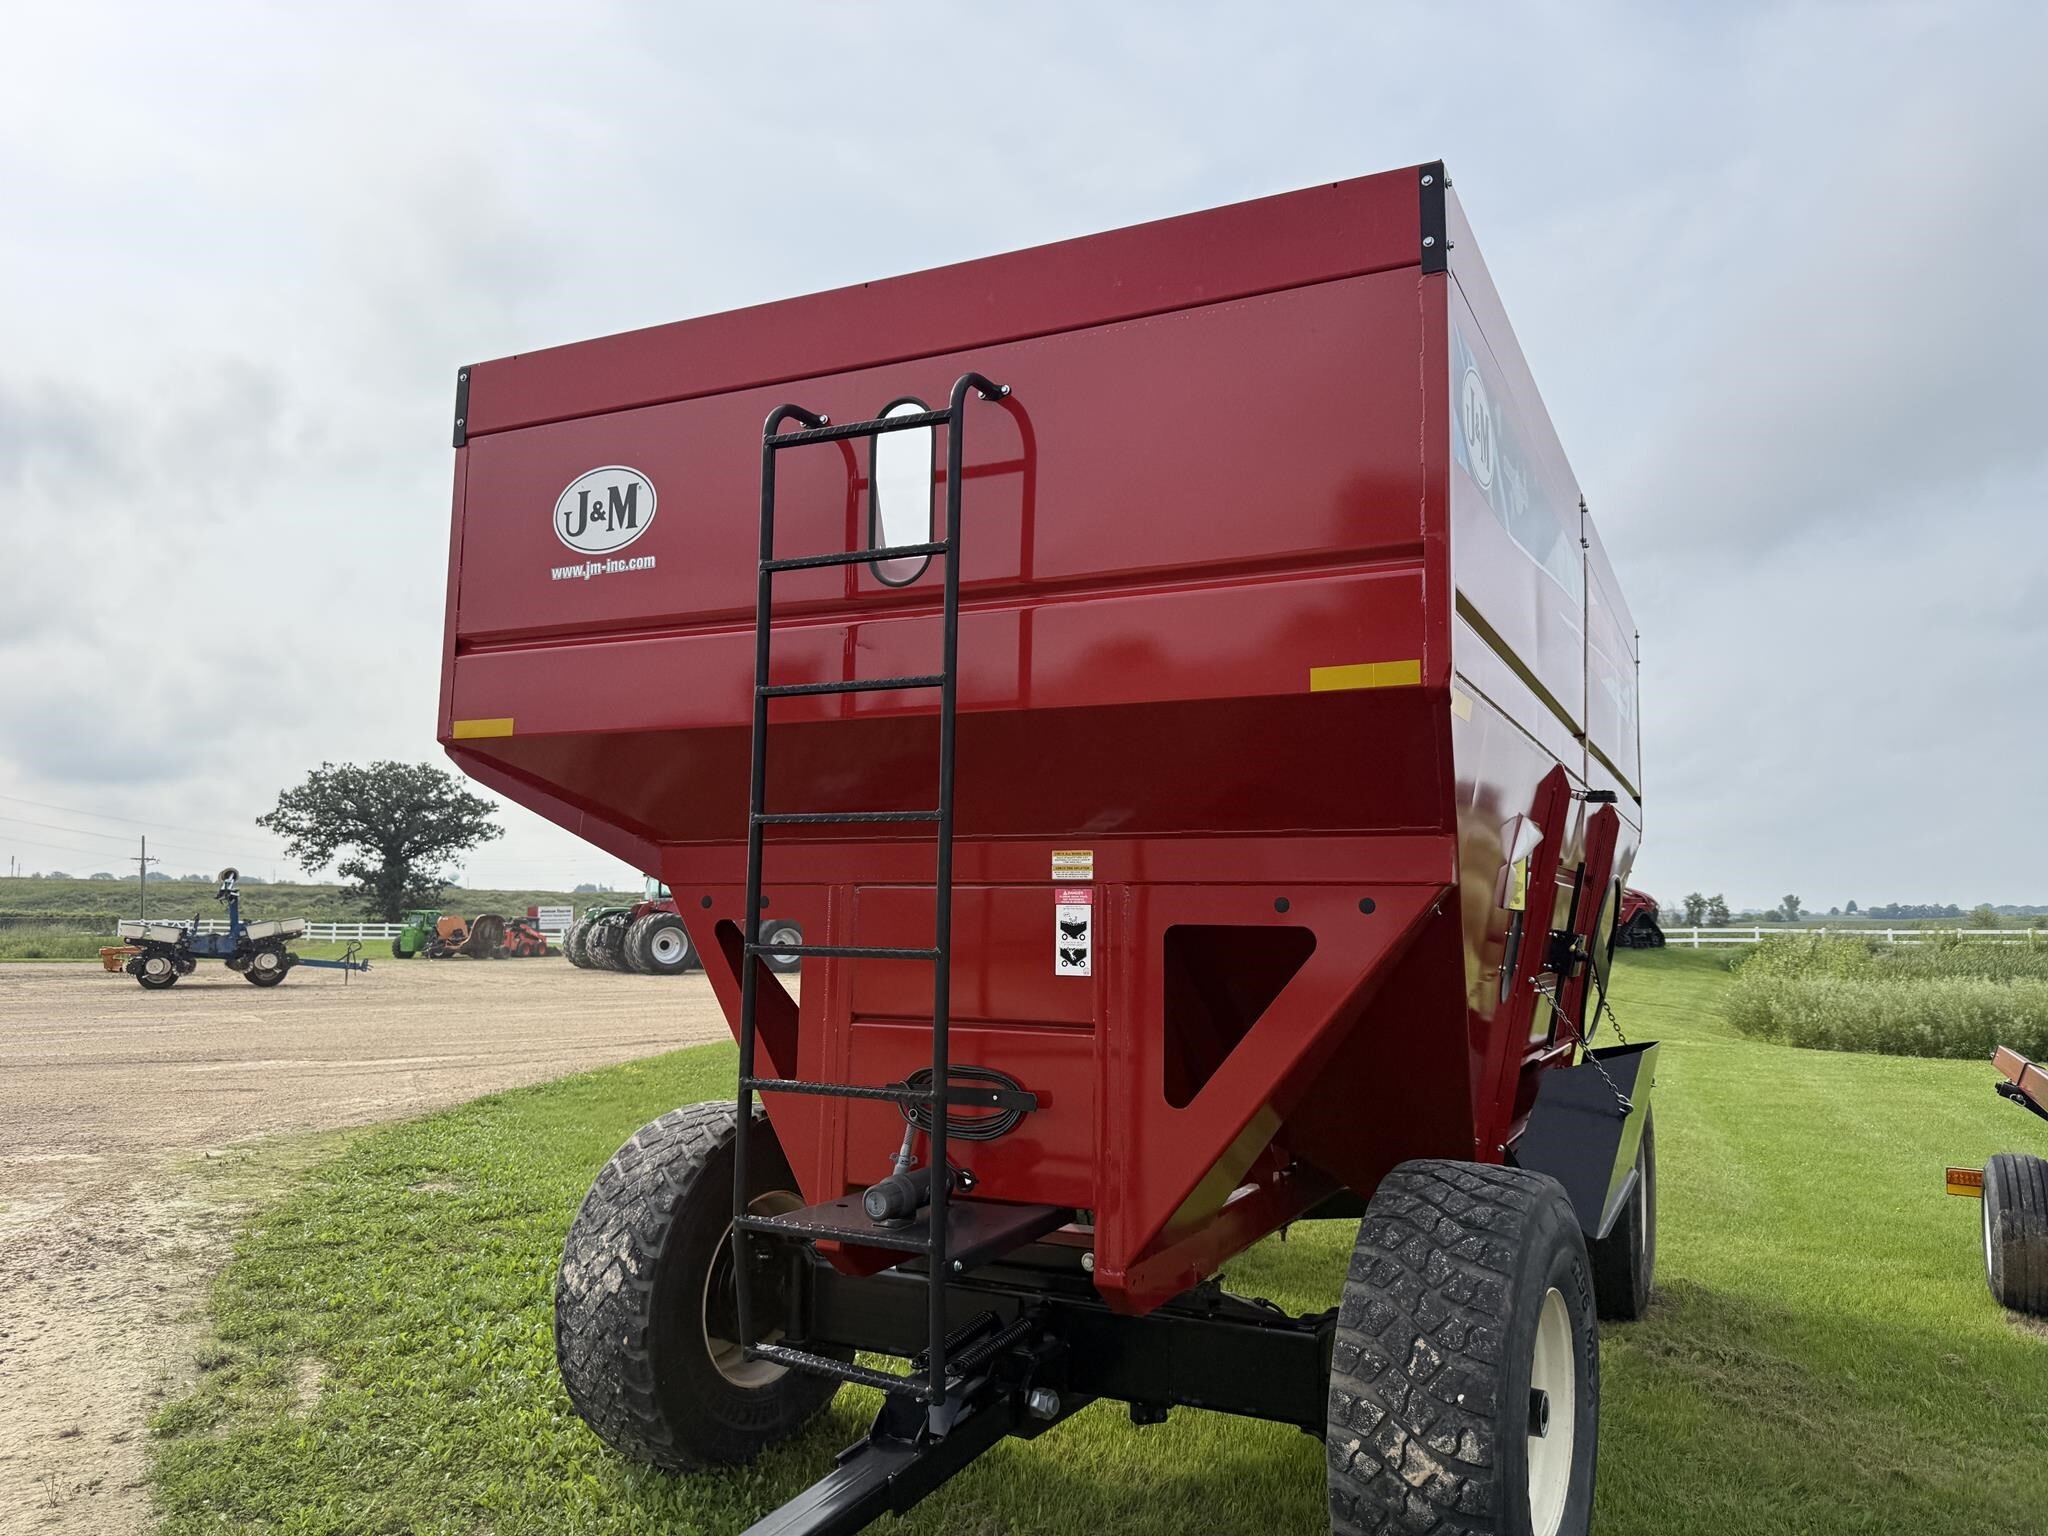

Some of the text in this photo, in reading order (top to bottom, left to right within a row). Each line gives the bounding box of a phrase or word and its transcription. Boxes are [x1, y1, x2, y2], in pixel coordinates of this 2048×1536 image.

[1466, 386, 1491, 474] J&M
[564, 483, 639, 537] J&M
[552, 556, 656, 580] www.jm-inc.com
